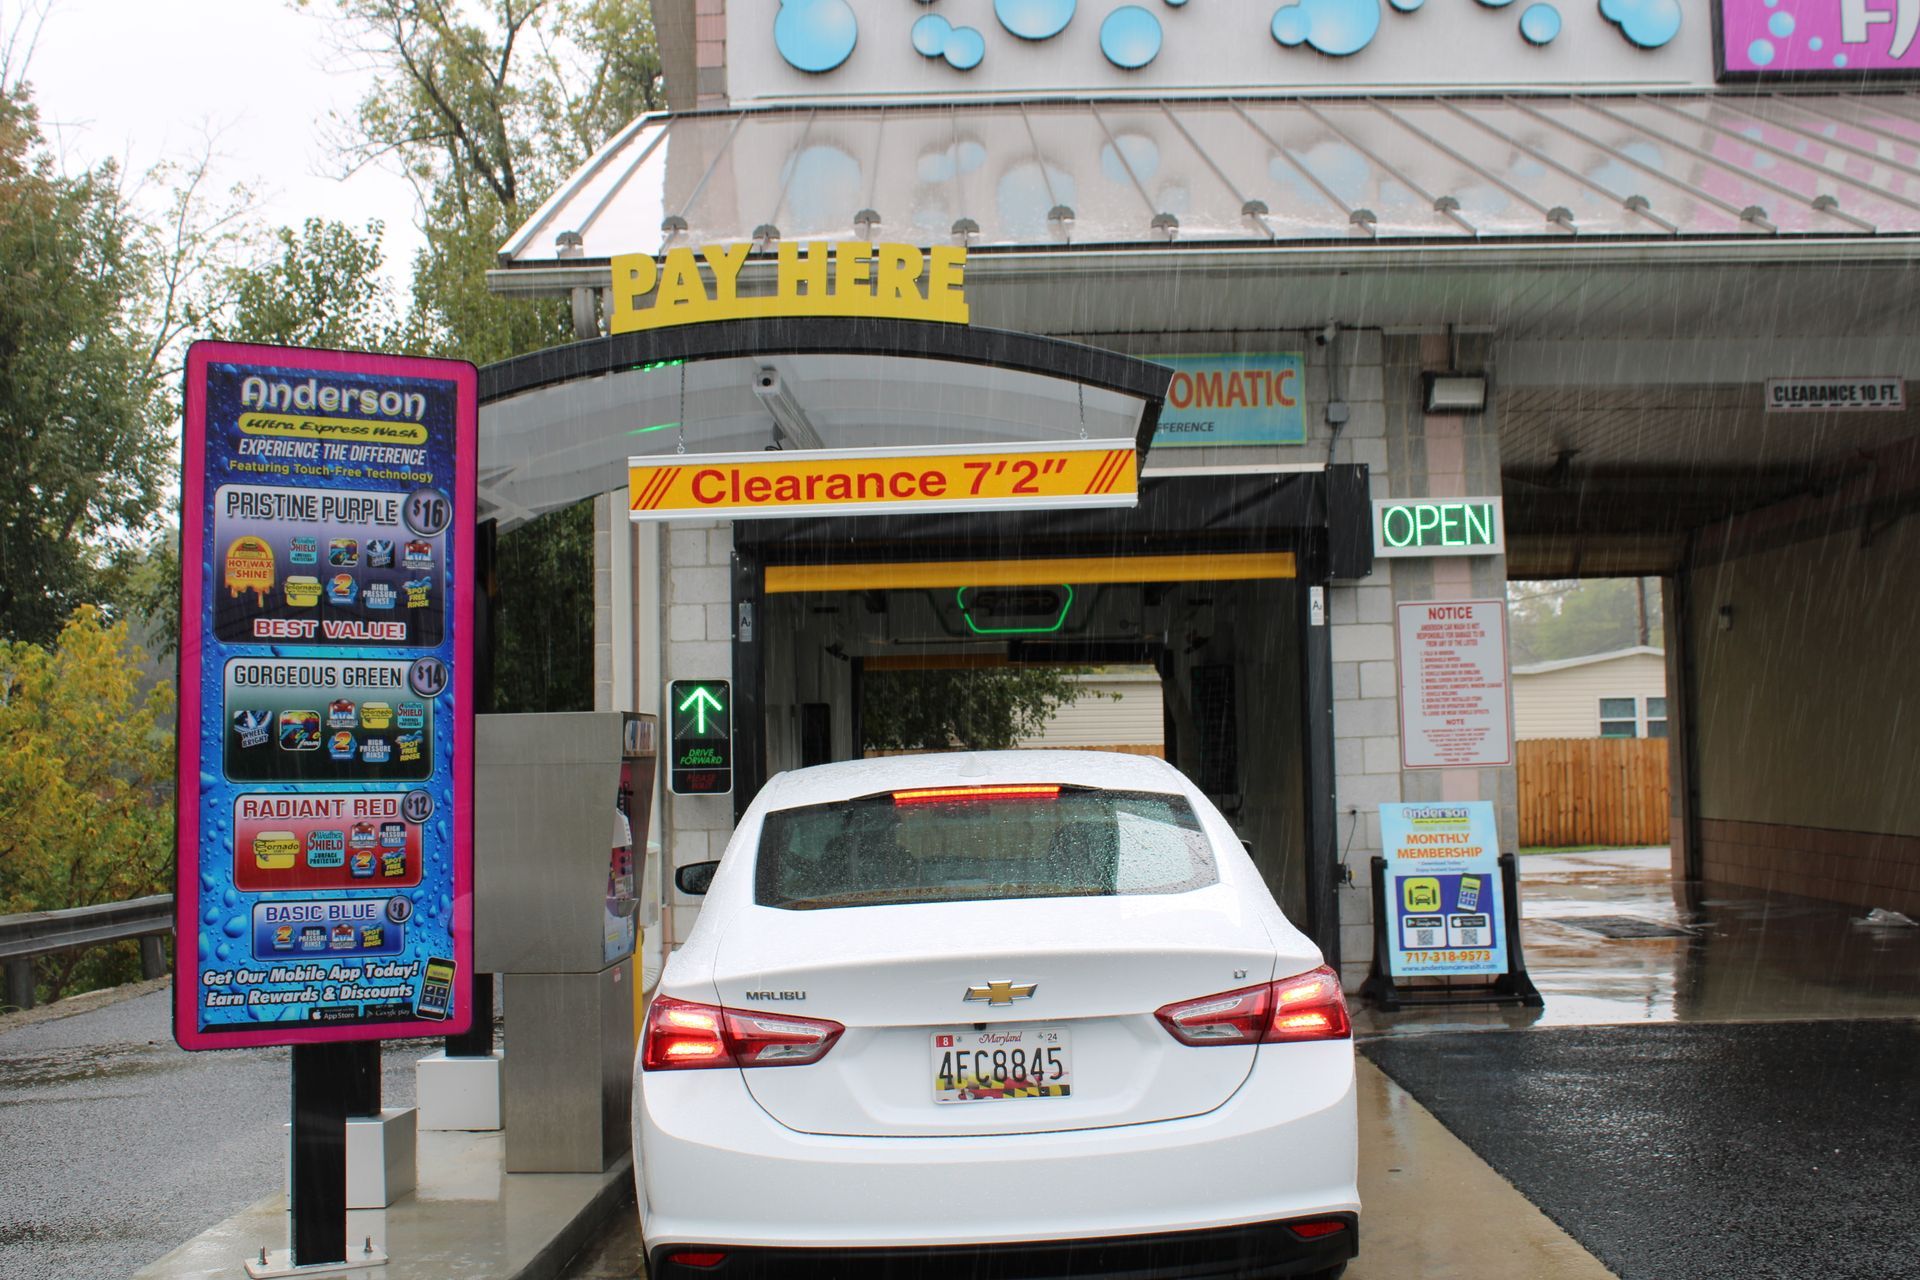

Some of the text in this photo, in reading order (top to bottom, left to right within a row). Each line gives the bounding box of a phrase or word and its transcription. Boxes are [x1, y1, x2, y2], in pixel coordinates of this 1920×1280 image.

[611, 241, 968, 314] PAY HERE
[241, 376, 426, 421] Anderson
[1774, 385, 1857, 401] CLEARANCE
[1860, 384, 1877, 400] 10
[246, 419, 419, 439] Ultra Express Wash
[239, 438, 426, 465] EXPERIENCE THE DIFFERENCE
[229, 460, 433, 483] Featuring Touch-Free Technology
[691, 469, 947, 504] Clearance
[226, 491, 398, 525] PRISTINE PURPLE
[413, 499, 444, 528] $16
[1384, 504, 1491, 547] OPEN
[228, 560, 248, 568] HOT
[236, 570, 268, 579] SHINE
[333, 573, 352, 595] 2
[407, 587, 426, 595] SPOT
[362, 591, 397, 599] PRESSURE
[407, 600, 430, 608] RINSE
[1428, 607, 1472, 620] NOTICE
[255, 619, 406, 640] BEST VALUE!
[234, 665, 402, 688] GORGEOUS GREEN
[418, 663, 442, 688] $14
[398, 704, 422, 716] SHIELD
[242, 728, 264, 739] WHEEL
[242, 734, 268, 747] BRIGHT
[333, 731, 351, 752] 2
[400, 753, 420, 761] RINSE
[680, 756, 722, 765] FORWARD
[689, 748, 714, 757] DRIVE
[243, 798, 398, 818] RADIANT RED
[408, 796, 428, 816] $12
[1403, 807, 1470, 818] Anderson
[308, 832, 343, 851] SHIELD
[1406, 833, 1470, 844] MONTHLY
[355, 851, 371, 868] 2
[1397, 847, 1483, 859] MEMBERSHIP
[385, 868, 404, 877] RINSE
[265, 904, 376, 923] BASIC BLUE
[276, 925, 293, 943] 2
[1406, 951, 1491, 963] 717-318-9573
[203, 961, 418, 986] Get Our Mobile App Today!
[1234, 970, 1247, 978] LT
[206, 984, 412, 1007] Earn Rewards & Discounts
[746, 991, 806, 1001] MALIBU
[324, 1011, 354, 1021] App Store
[943, 1037, 949, 1046] 8
[979, 1032, 1022, 1046] Maryland
[1047, 1033, 1058, 1041] 24
[940, 1047, 1063, 1083] 4FC8845
